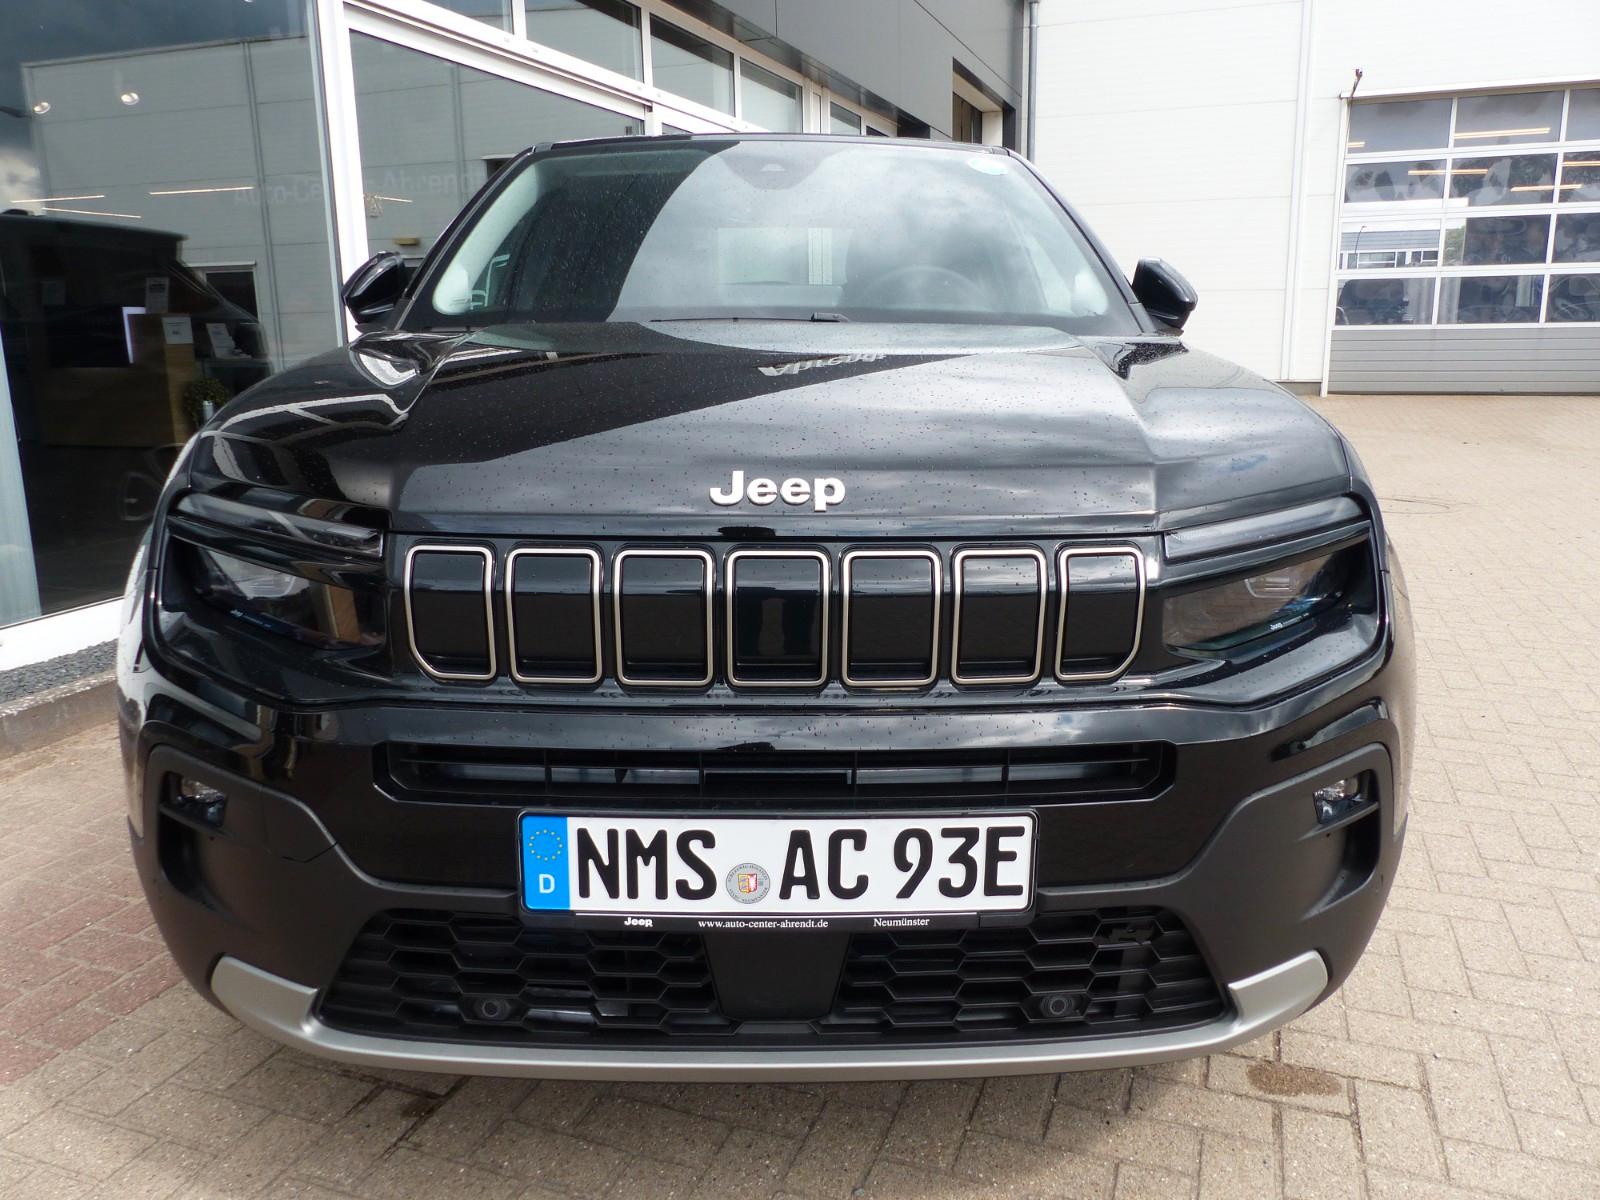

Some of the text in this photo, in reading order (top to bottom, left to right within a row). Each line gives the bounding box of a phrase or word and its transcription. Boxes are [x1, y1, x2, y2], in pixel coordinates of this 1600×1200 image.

[709, 470, 846, 512] Jeep
[576, 828, 717, 900] NMS
[779, 829, 869, 900] AC
[893, 826, 1026, 899] 93E
[538, 874, 556, 894] D
[624, 917, 653, 927] Jeep
[698, 919, 829, 929] www.auto-center-ahrendt.de
[873, 917, 930, 928] Neumünster
